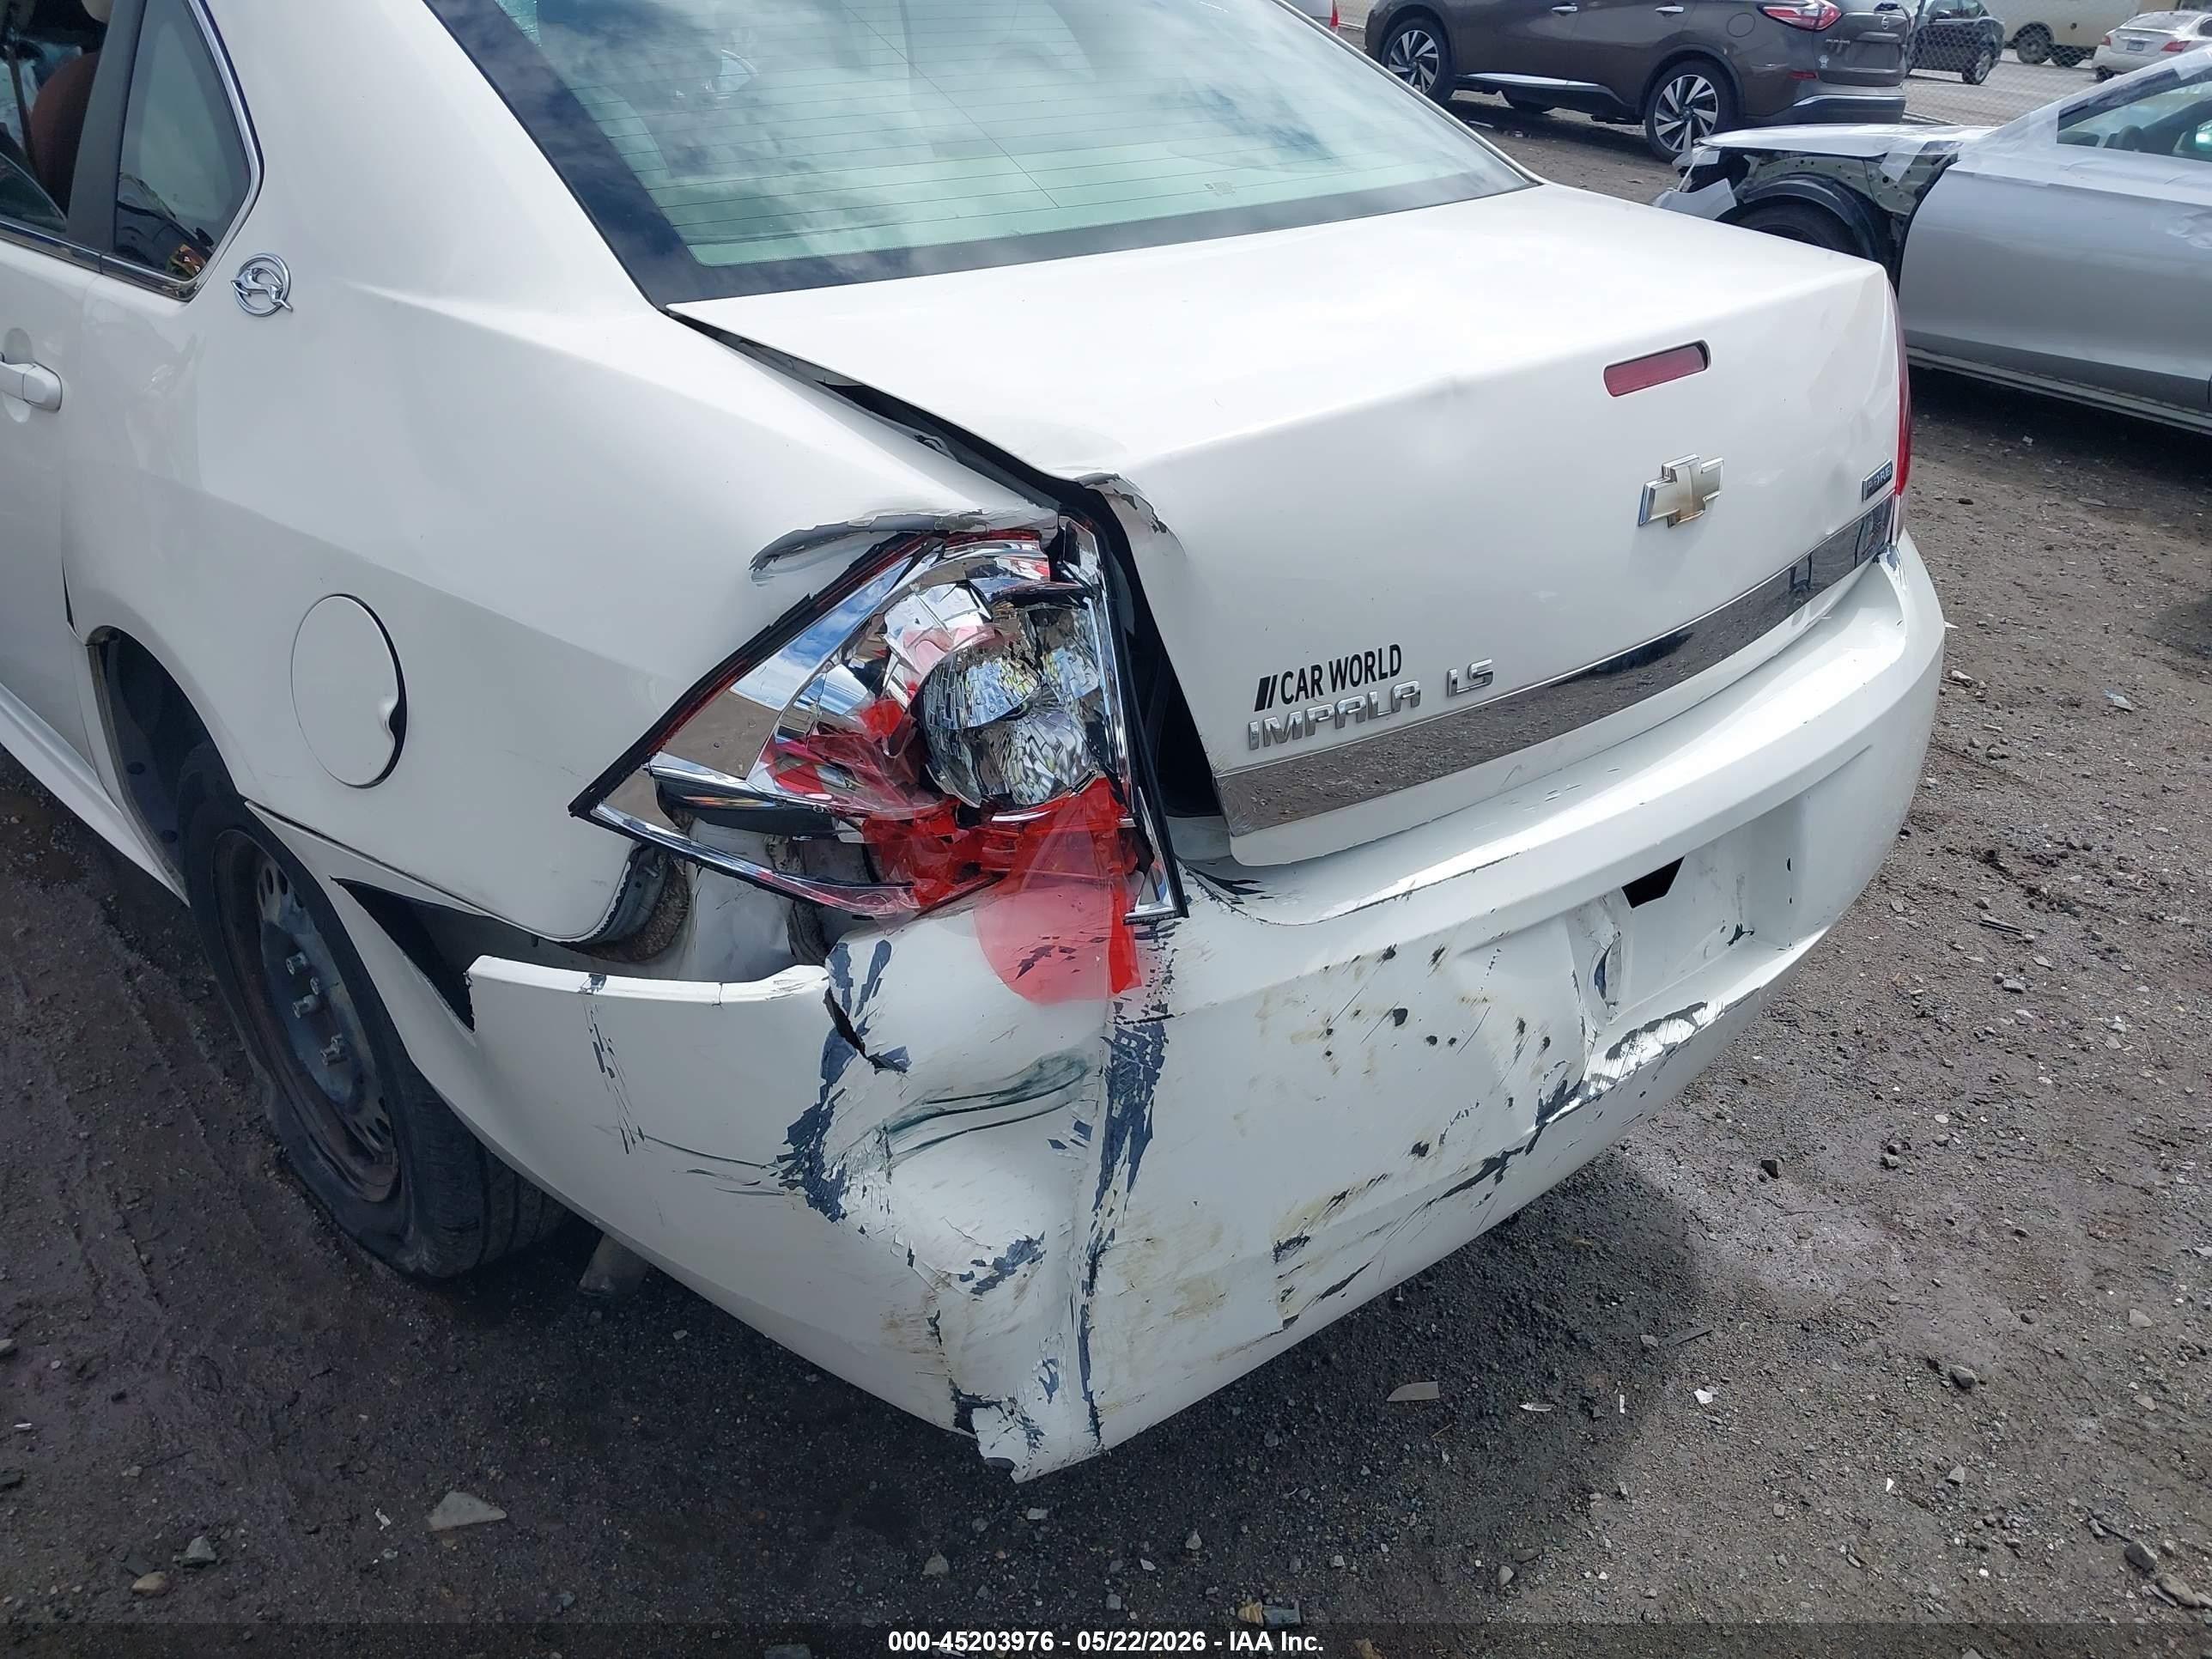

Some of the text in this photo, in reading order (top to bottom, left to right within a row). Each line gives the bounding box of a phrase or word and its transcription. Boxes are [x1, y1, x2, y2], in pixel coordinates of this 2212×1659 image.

[1248, 659, 1494, 750] IMPALA LS
[1280, 644, 1402, 705] CAR WORLD
